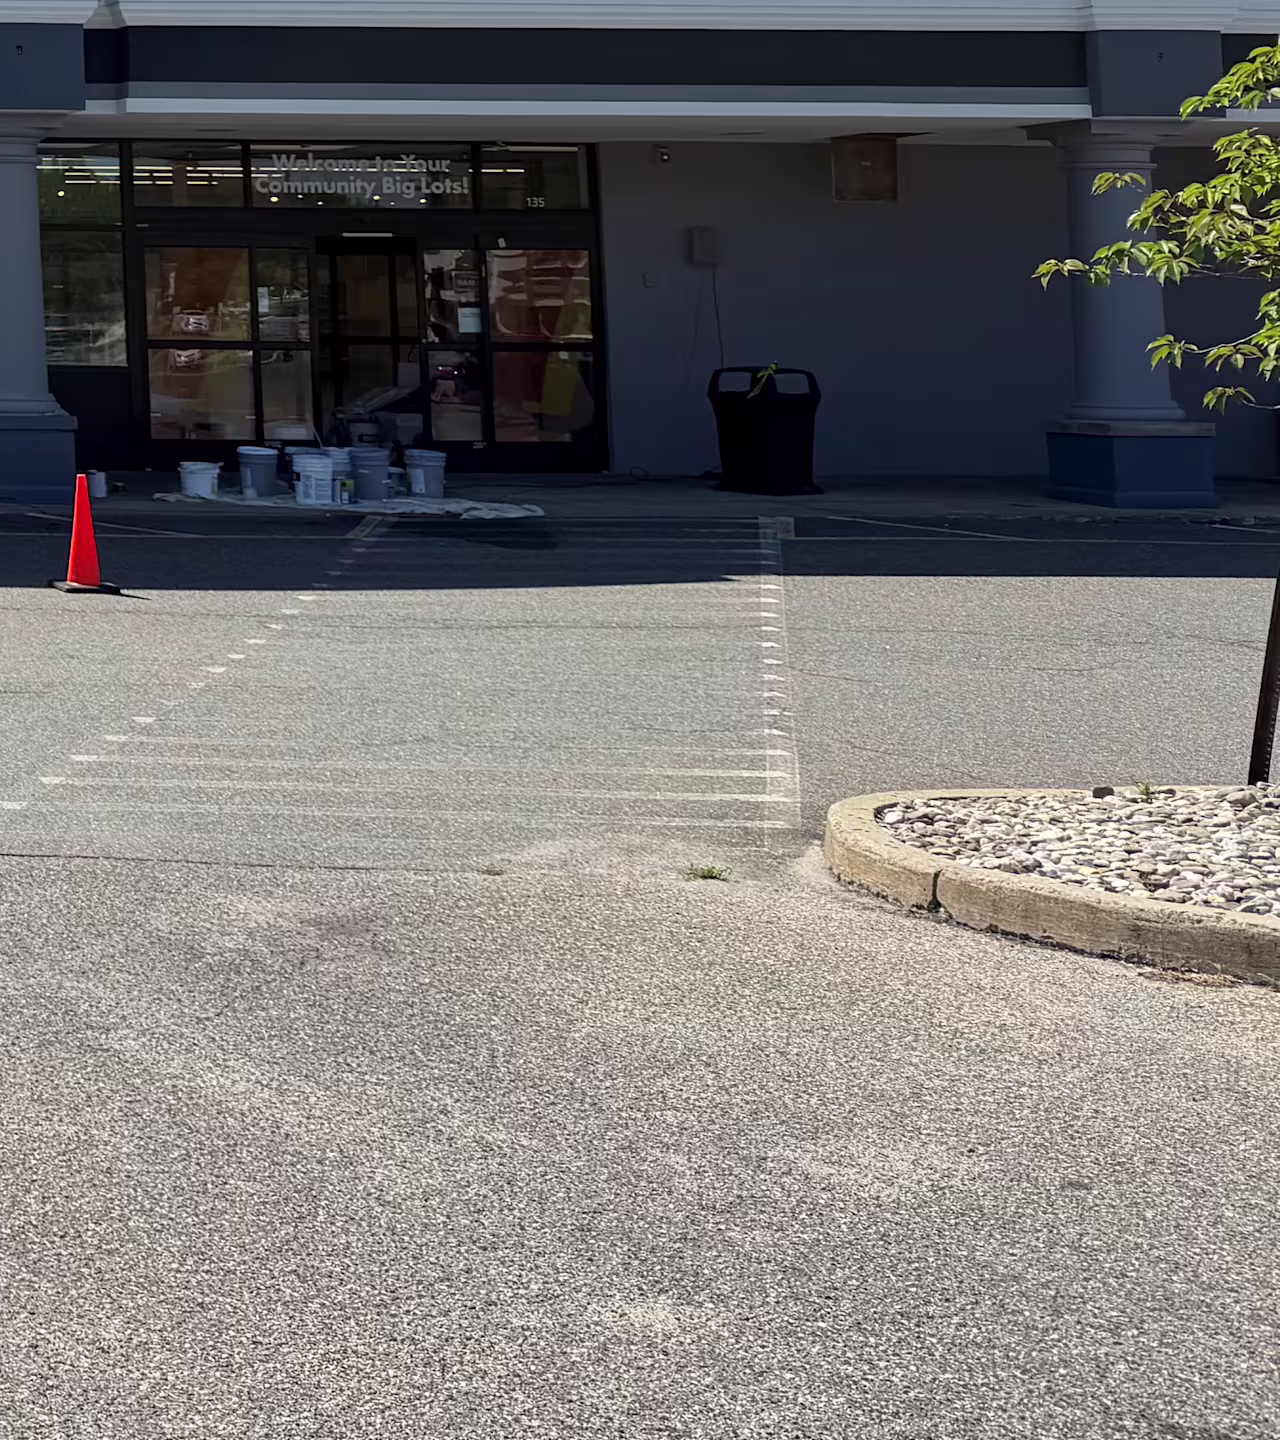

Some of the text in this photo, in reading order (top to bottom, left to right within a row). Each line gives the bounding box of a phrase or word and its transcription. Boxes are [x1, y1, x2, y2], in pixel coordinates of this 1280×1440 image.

[272, 153, 450, 172] Welcome to Your
[255, 176, 469, 199] Community Big Lots!
[526, 196, 545, 208] 135
